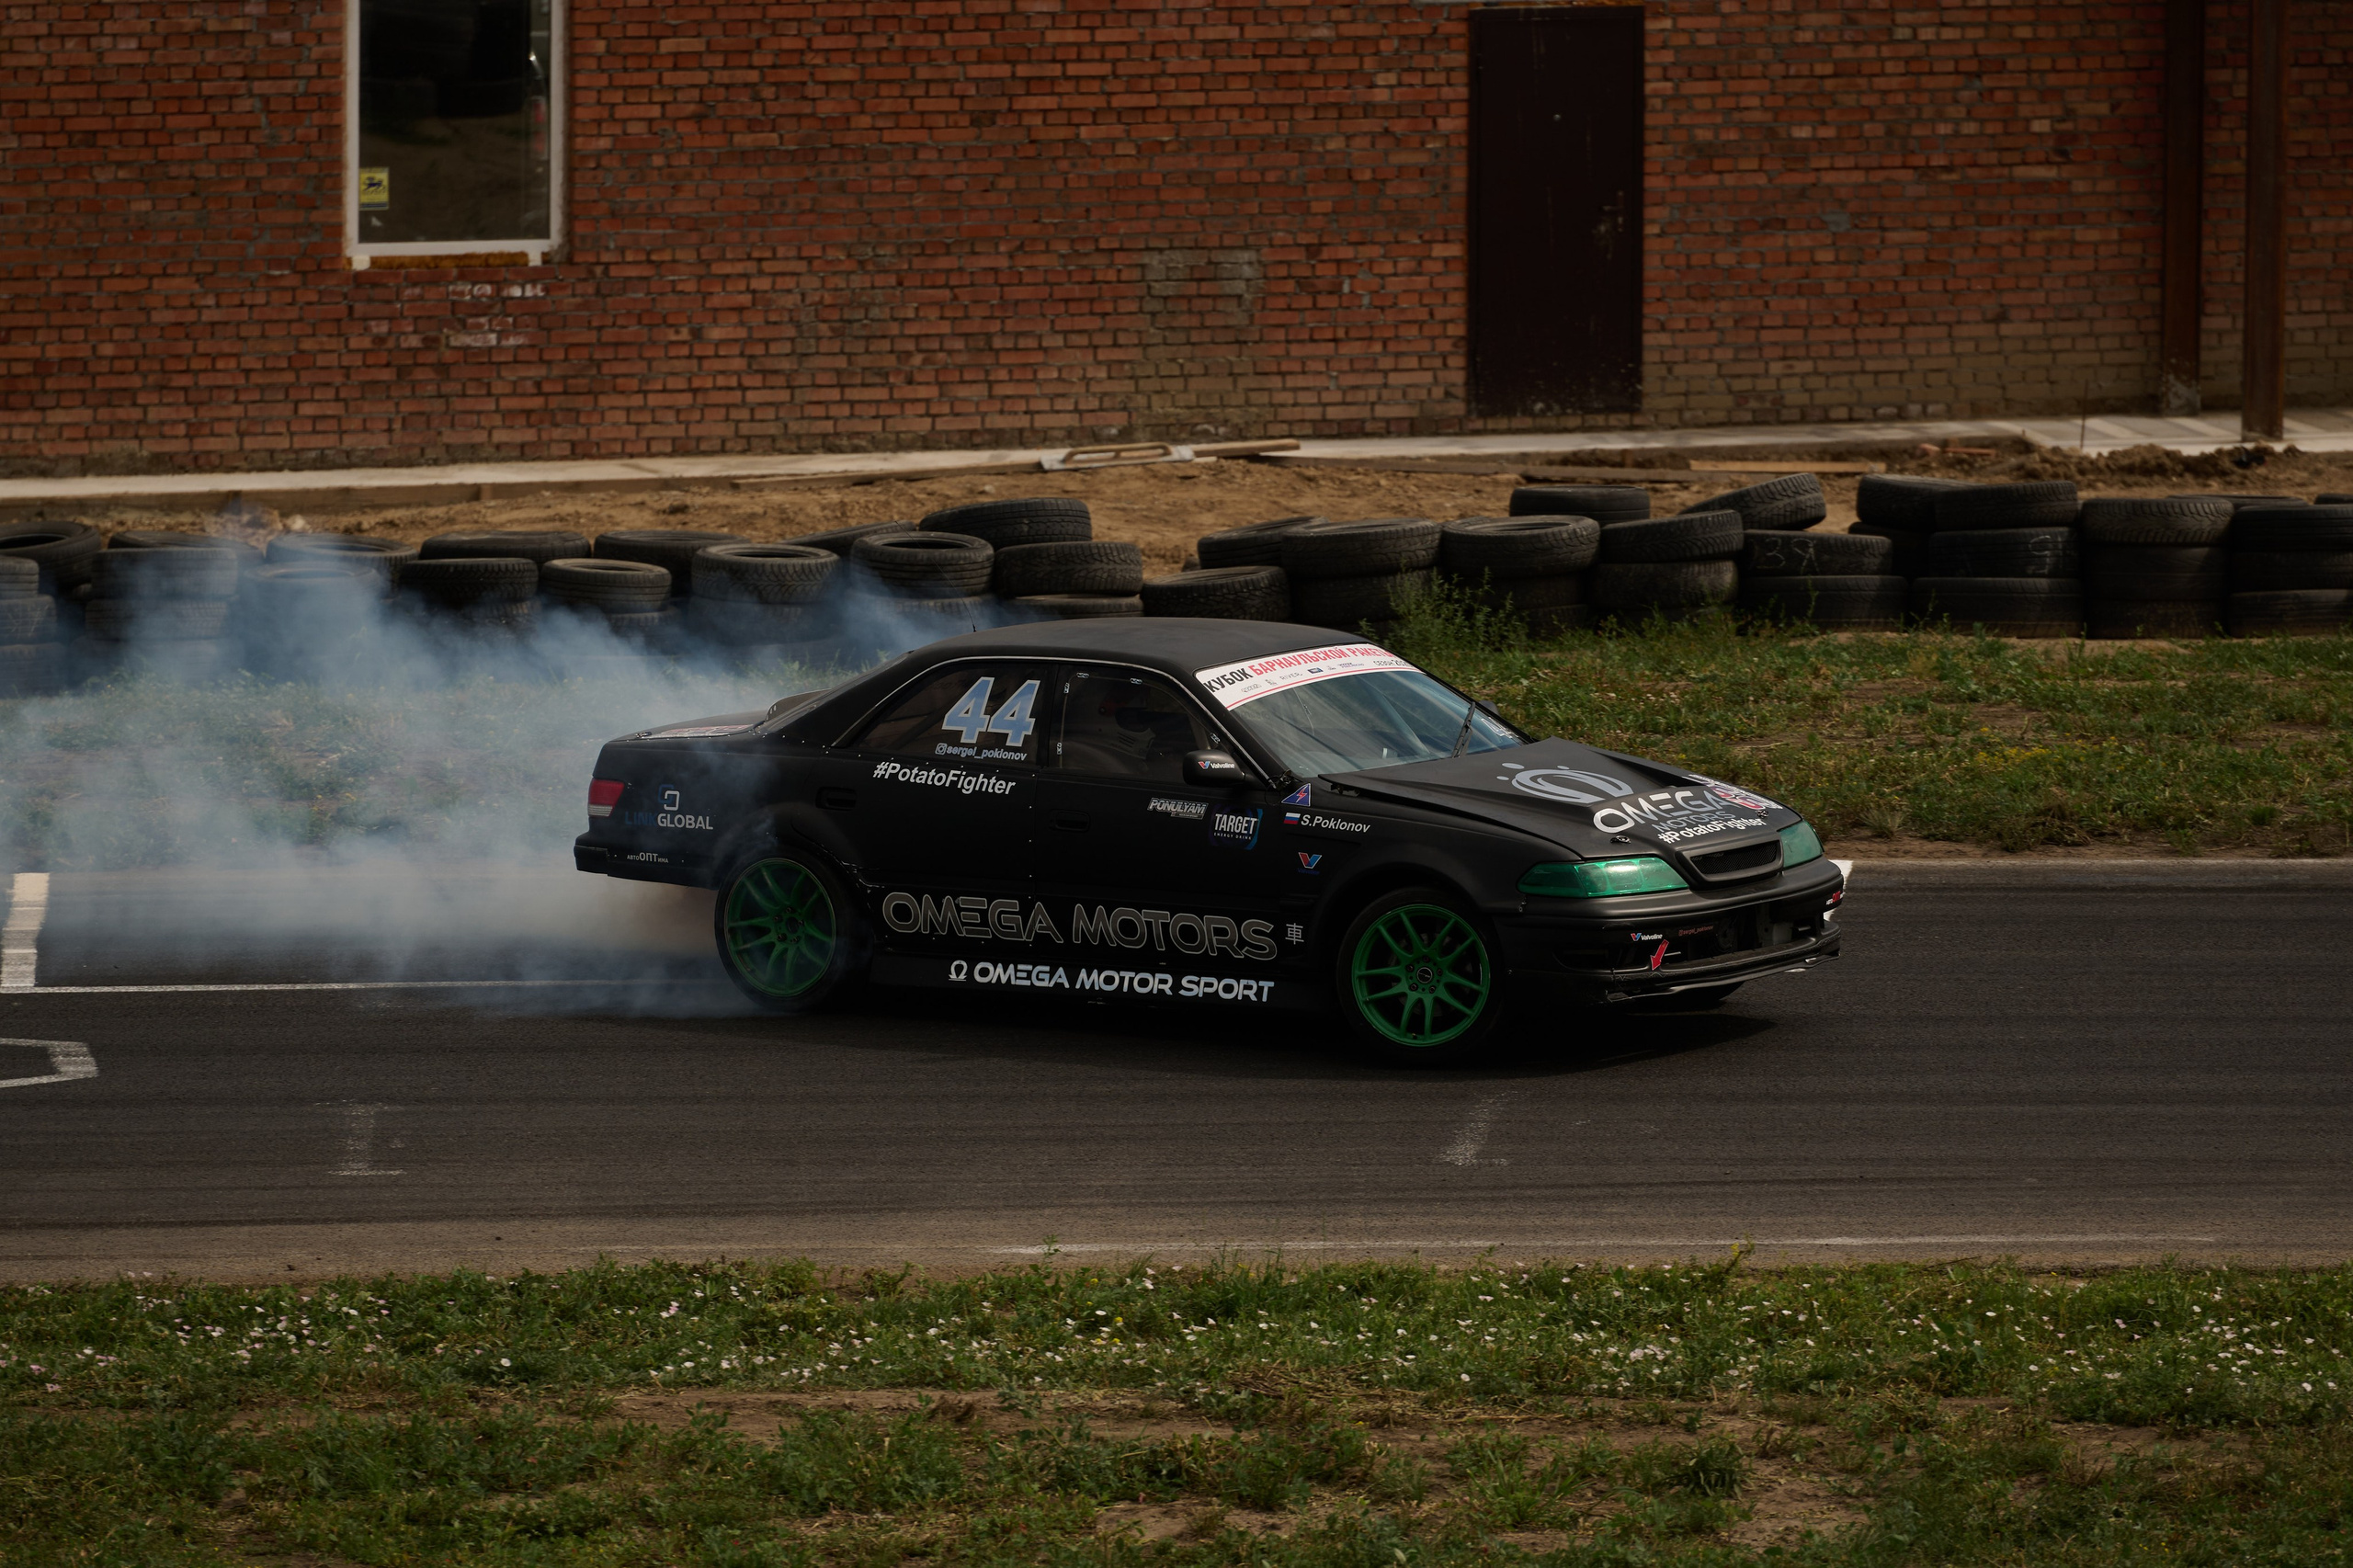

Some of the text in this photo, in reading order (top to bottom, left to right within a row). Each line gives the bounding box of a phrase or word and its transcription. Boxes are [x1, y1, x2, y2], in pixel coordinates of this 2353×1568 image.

[1203, 667, 1254, 693] КУБОК
[1247, 646, 1350, 676] БАРНАУЛЬСКОЙ
[941, 676, 1040, 747] 44
[872, 761, 1017, 795] #PotatoFighter
[1214, 812, 1258, 835] TARGET
[1301, 814, 1371, 833] S.Poklonov
[1593, 790, 1741, 834] OMEGA
[1652, 810, 1736, 833] MOTORS
[1657, 816, 1768, 844] #PotatoFighter
[881, 892, 1278, 960] OMEGA MOTORS
[1284, 922, 1305, 946] 車
[1641, 933, 1663, 941] Valvoline
[972, 961, 1070, 989] OMEGA
[1074, 968, 1173, 996] MOTOR
[1178, 974, 1275, 1003] SPORT
